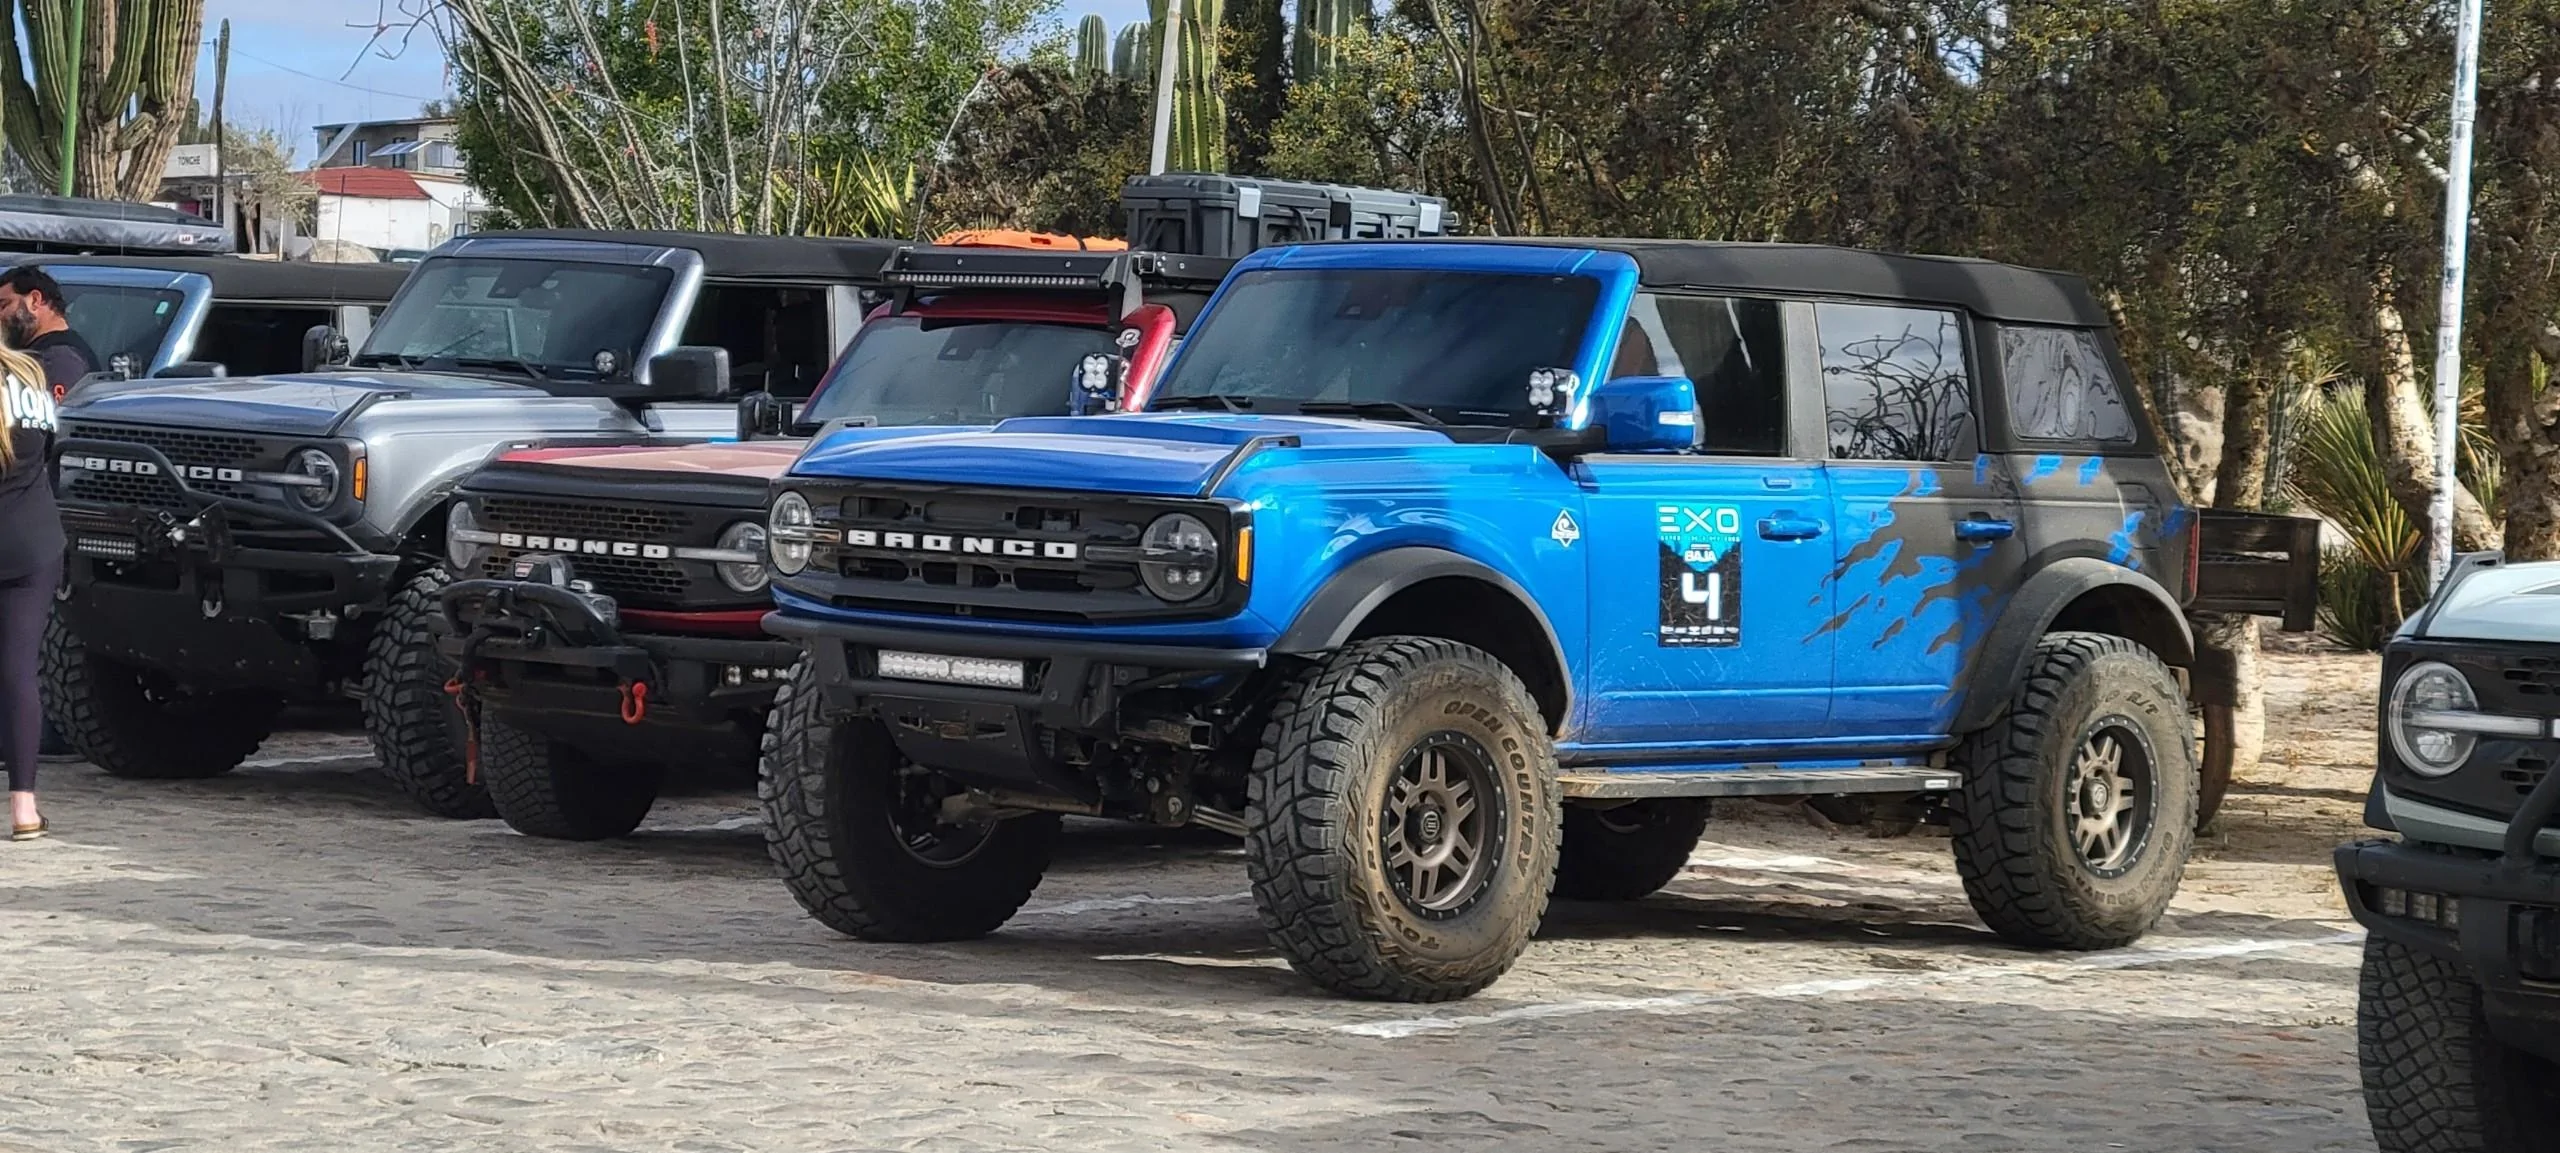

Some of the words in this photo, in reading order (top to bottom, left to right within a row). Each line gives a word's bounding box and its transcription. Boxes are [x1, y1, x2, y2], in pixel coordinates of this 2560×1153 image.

[1658, 506, 1740, 534] EXO
[500, 532, 670, 559] BRONCO
[847, 529, 1078, 559] BRONCO
[1684, 550, 1718, 563] BAJA
[1681, 572, 1720, 621] 4
[1443, 700, 1504, 734] OPEN
[1501, 736, 1535, 878] COUNTRY
[1376, 890, 1441, 950] TOYO
